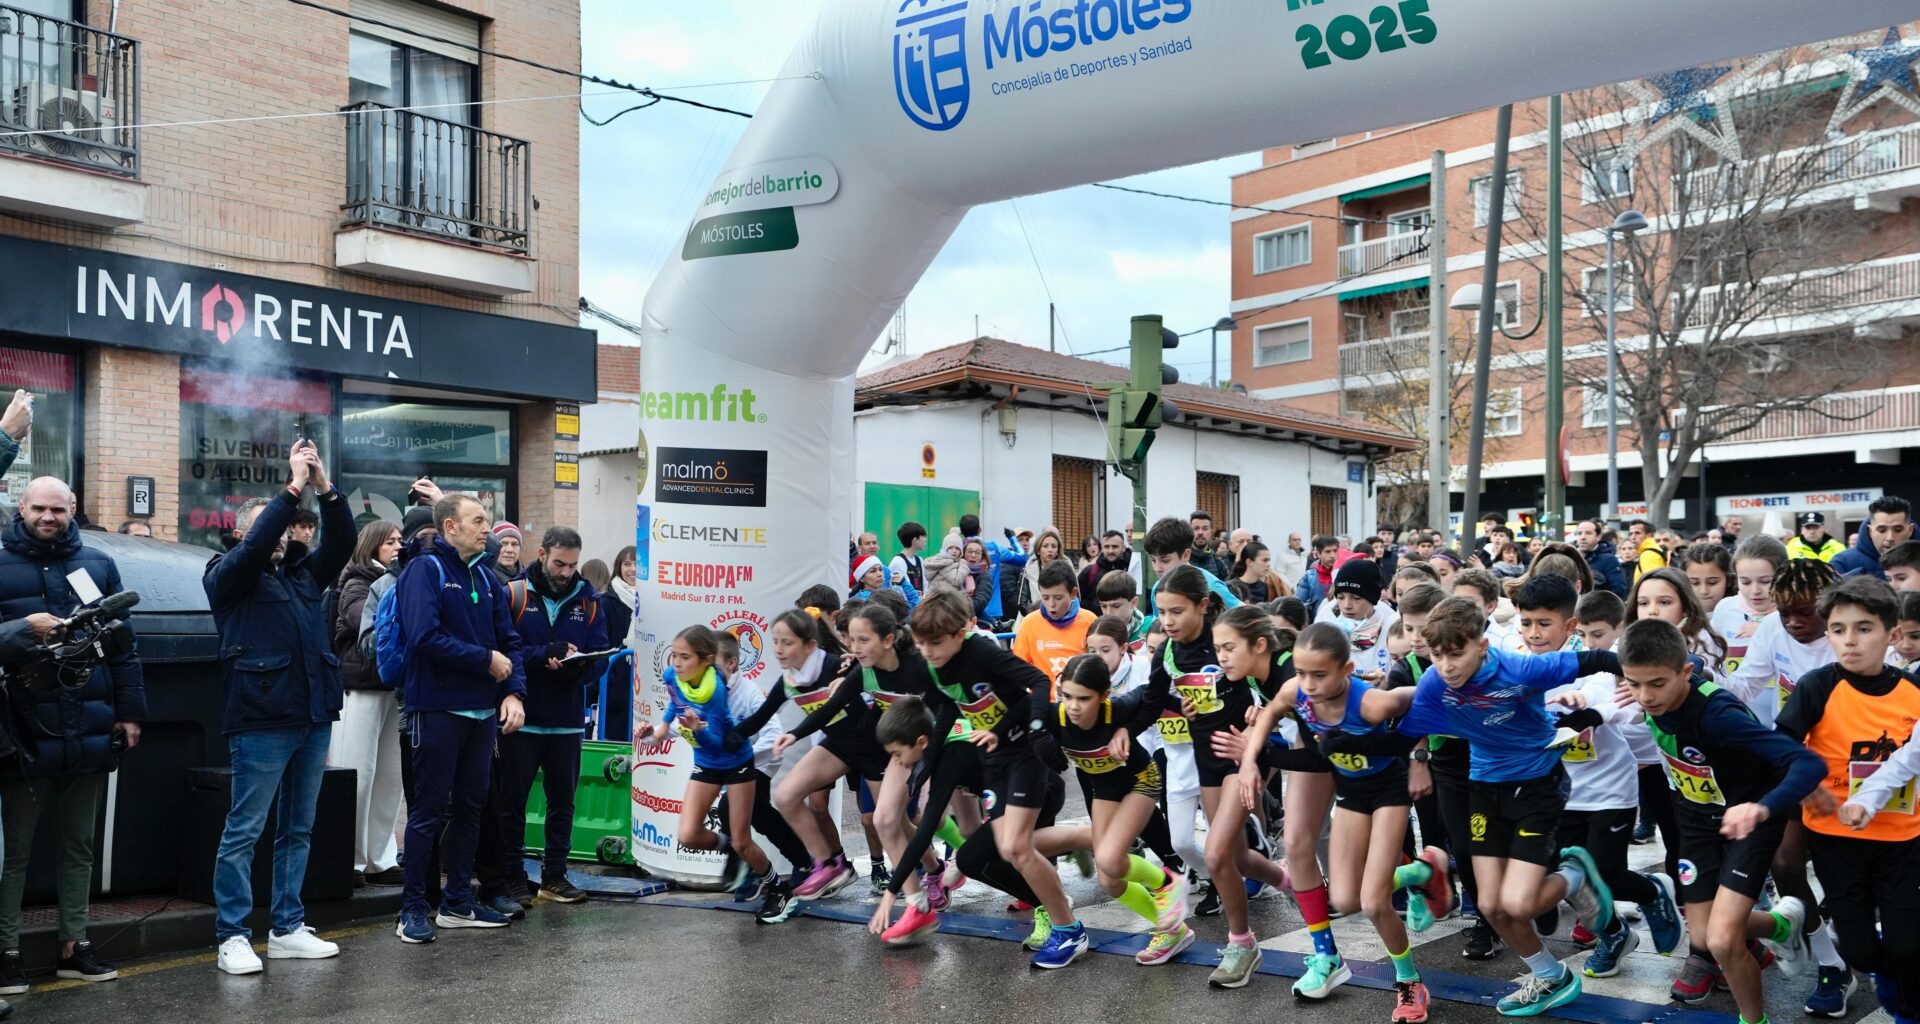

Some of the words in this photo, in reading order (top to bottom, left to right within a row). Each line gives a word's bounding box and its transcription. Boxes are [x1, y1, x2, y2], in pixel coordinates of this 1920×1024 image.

[983, 0, 1192, 69] Móstoles
[1295, 0, 1437, 69] 2025
[991, 70, 1052, 96] Concejalía
[1054, 68, 1069, 82] de
[1071, 54, 1128, 78] Deportes
[1130, 52, 1139, 65] y
[1139, 36, 1193, 61] Sanidad
[700, 223, 764, 244] MÓSTOLES
[640, 384, 756, 422] reamfit
[199, 437, 219, 455] SI
[662, 460, 728, 480] malmö
[1728, 496, 1790, 509] TECNORETE
[1804, 492, 1871, 505] TECNORETE
[660, 523, 768, 544] CLEMENTE
[661, 591, 686, 602] Madrid
[688, 593, 702, 603] Sur
[704, 594, 725, 605] 87.8
[727, 595, 746, 605] FM.
[710, 610, 769, 633] POLLERÍA
